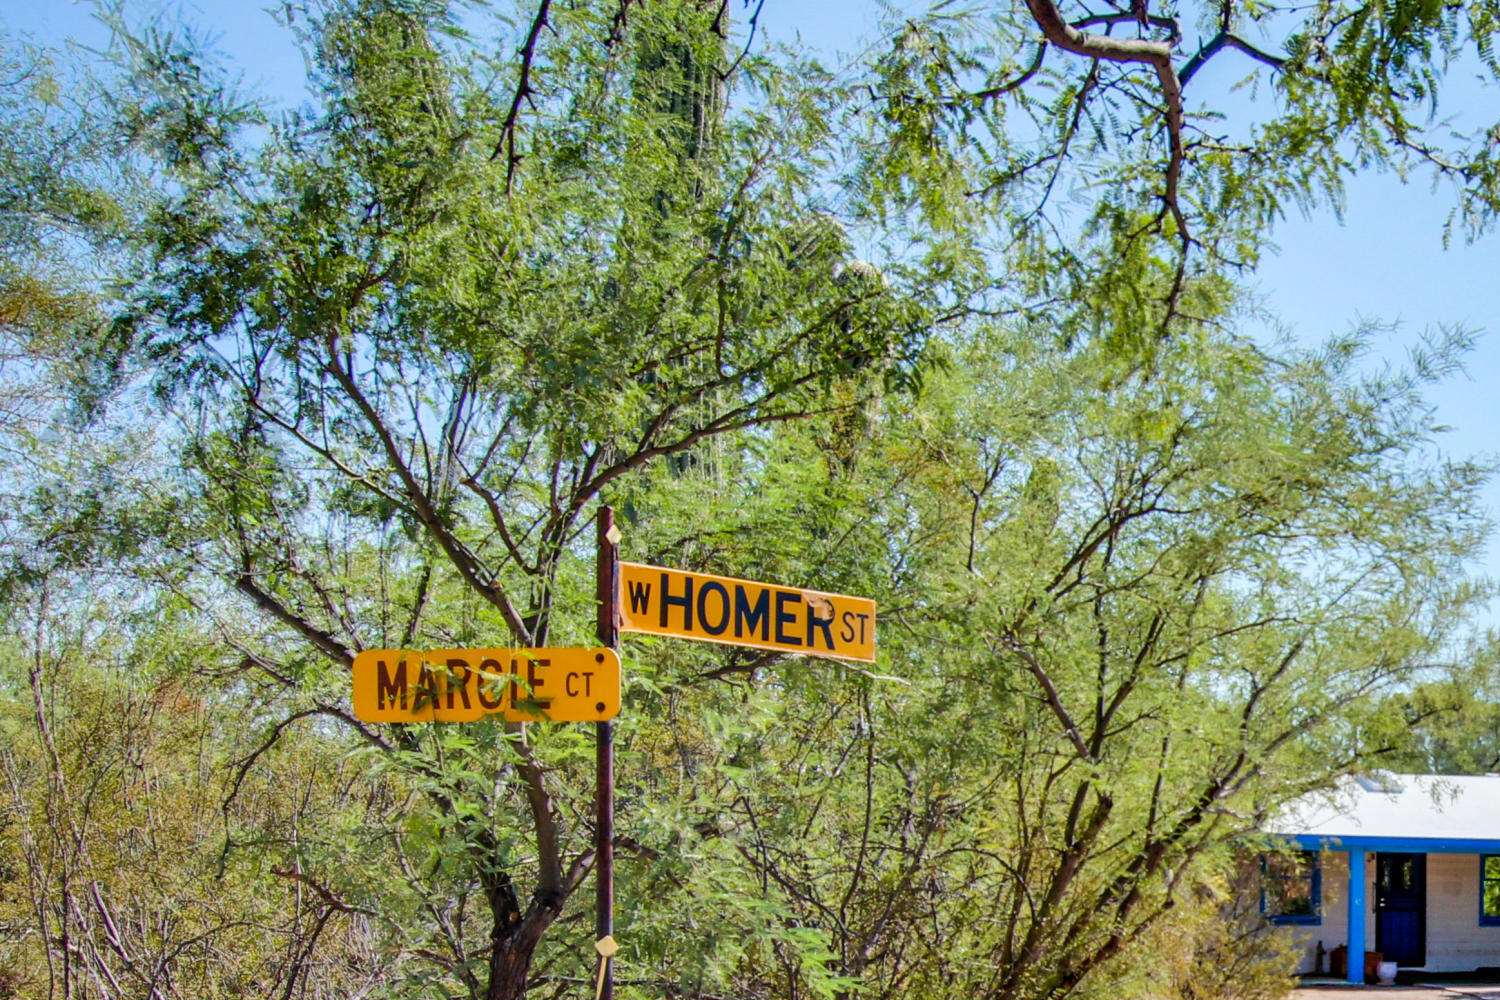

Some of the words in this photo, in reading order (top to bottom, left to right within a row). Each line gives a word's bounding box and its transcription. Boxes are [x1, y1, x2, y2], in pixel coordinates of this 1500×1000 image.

[628, 580, 652, 616] W
[659, 573, 836, 651] HOMER
[840, 610, 870, 646] ST
[565, 671, 595, 698] CT
